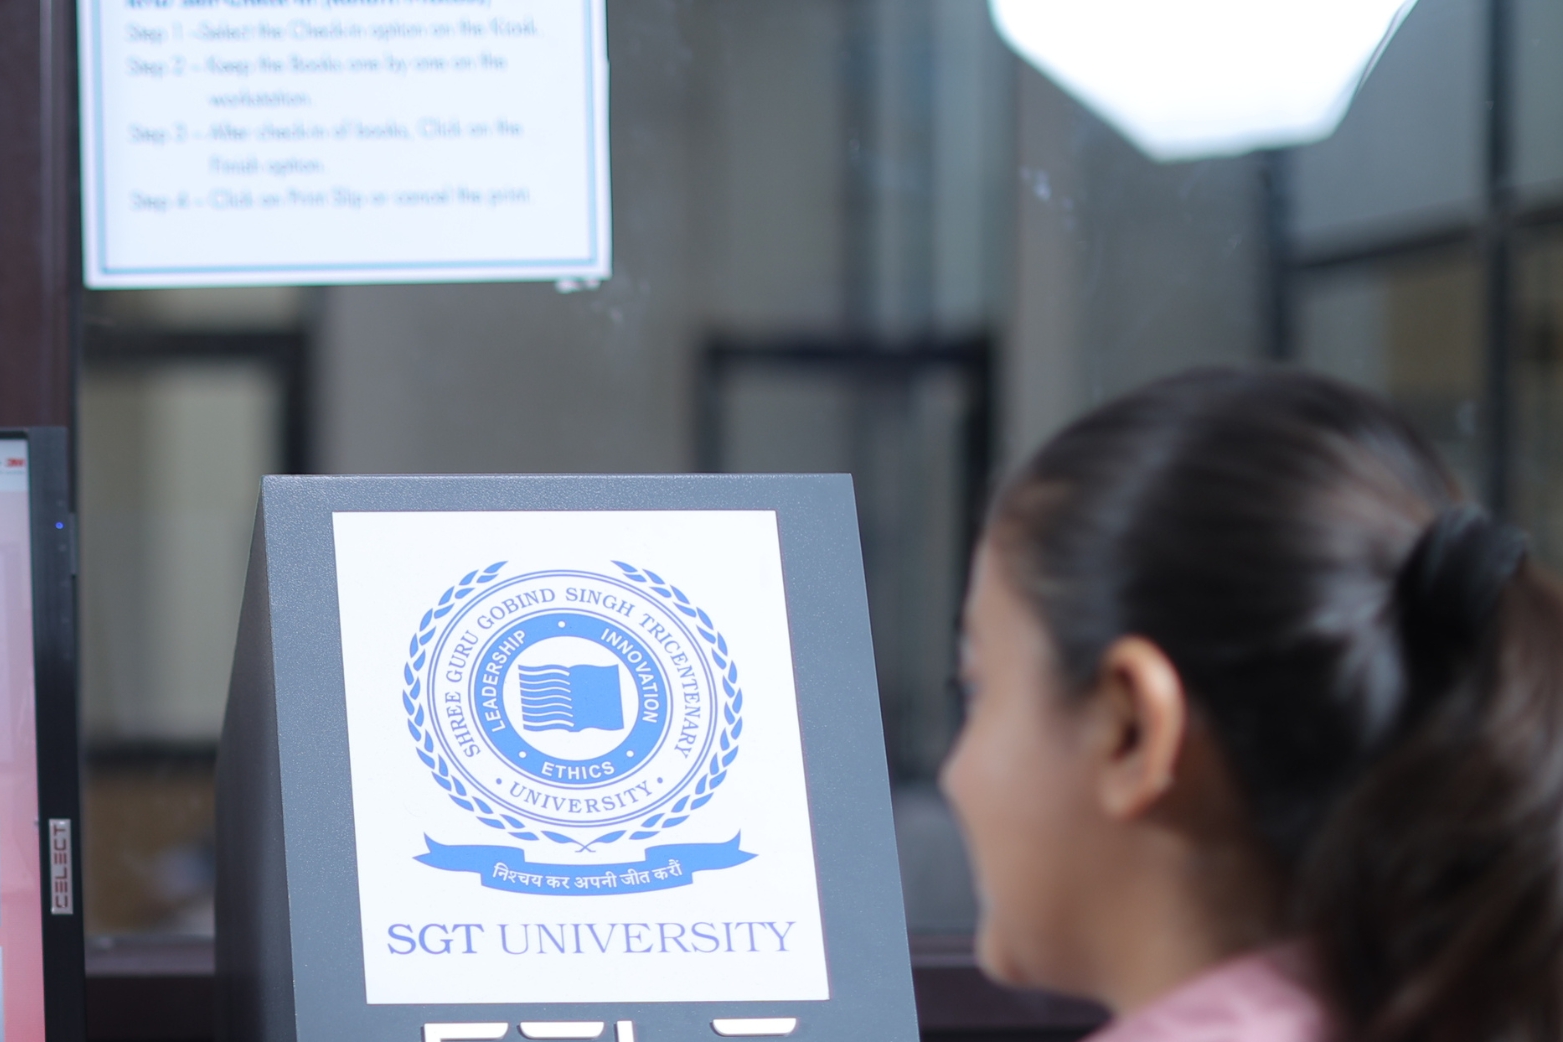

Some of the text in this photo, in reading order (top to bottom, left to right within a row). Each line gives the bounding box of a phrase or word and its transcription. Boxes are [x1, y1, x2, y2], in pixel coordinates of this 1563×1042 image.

[444, 587, 701, 759] SHREE GURU GOBIND SINGH TRICENTENARY
[481, 628, 528, 733] LEADERSHIP
[600, 627, 661, 724] INNOVATION
[541, 760, 616, 781] ETHICS
[508, 780, 654, 814] UNIVERSITY
[492, 862, 543, 888] निश्चय
[546, 876, 570, 889] कर
[574, 871, 617, 889] अपनी
[619, 868, 650, 886] जीत
[386, 921, 797, 956] SGT UNIVERSITY
